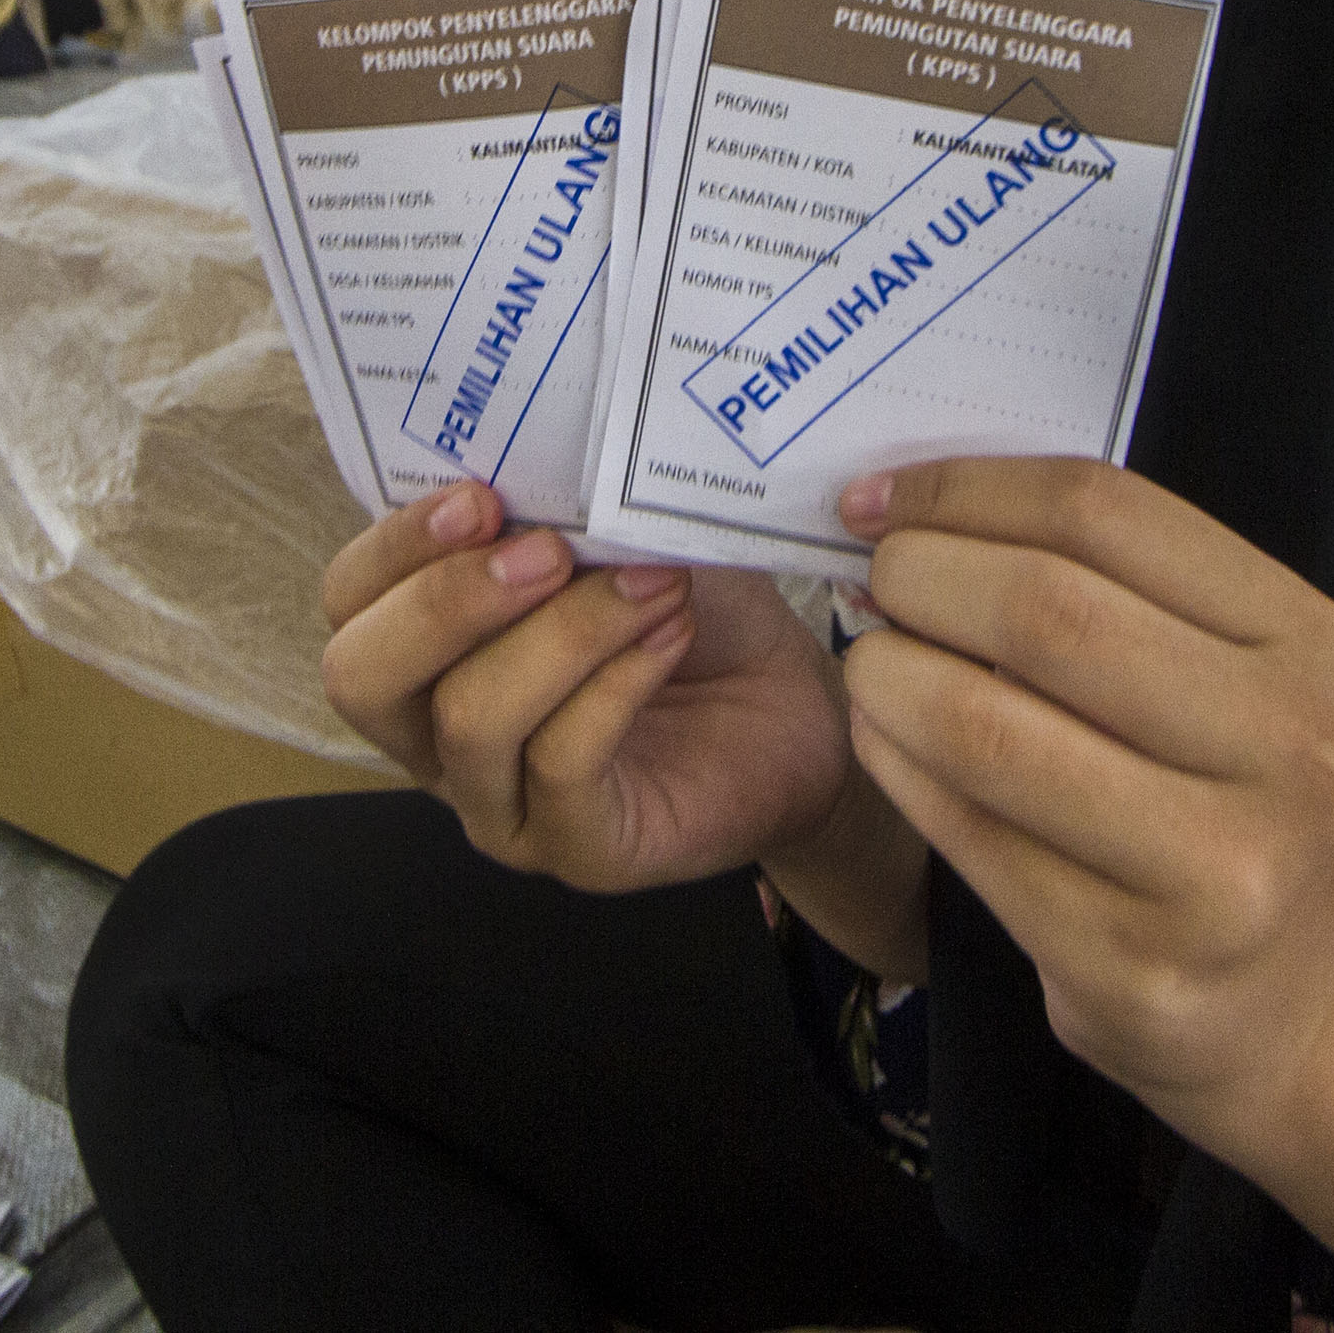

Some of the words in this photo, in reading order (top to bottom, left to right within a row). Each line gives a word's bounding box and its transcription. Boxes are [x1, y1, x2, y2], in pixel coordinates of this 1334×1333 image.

[317, 16, 434, 49] KELOMPOK
[362, 38, 512, 73] PEMUNGUTAN
[518, 27, 595, 58] SUARA
[833, 7, 998, 58] PEMUNGUTAN
[1003, 36, 1083, 73] SUARA
[471, 133, 581, 160] KALIMANTAN
[715, 90, 789, 119] PROVINSI
[913, 129, 1032, 164] KALIMANTAN
[707, 134, 799, 169] KABUPATEN
[814, 158, 855, 179] KOTA
[698, 180, 798, 214] KECAMATAN
[811, 204, 871, 228] DISTRIK
[690, 222, 730, 247] DESA
[745, 233, 840, 267] KELURAHAN
[435, 264, 546, 463] PEMILIHAN
[523, 104, 622, 263] ULANG
[682, 266, 744, 294] NOMOR
[748, 279, 773, 300] TPS
[717, 239, 933, 433] PEMILIHAN
[927, 116, 1080, 248] ULANG
[670, 331, 717, 357] NAMA
[723, 343, 774, 367] KETUA
[647, 458, 697, 485] TANDA
[702, 472, 766, 500] TANGAN
